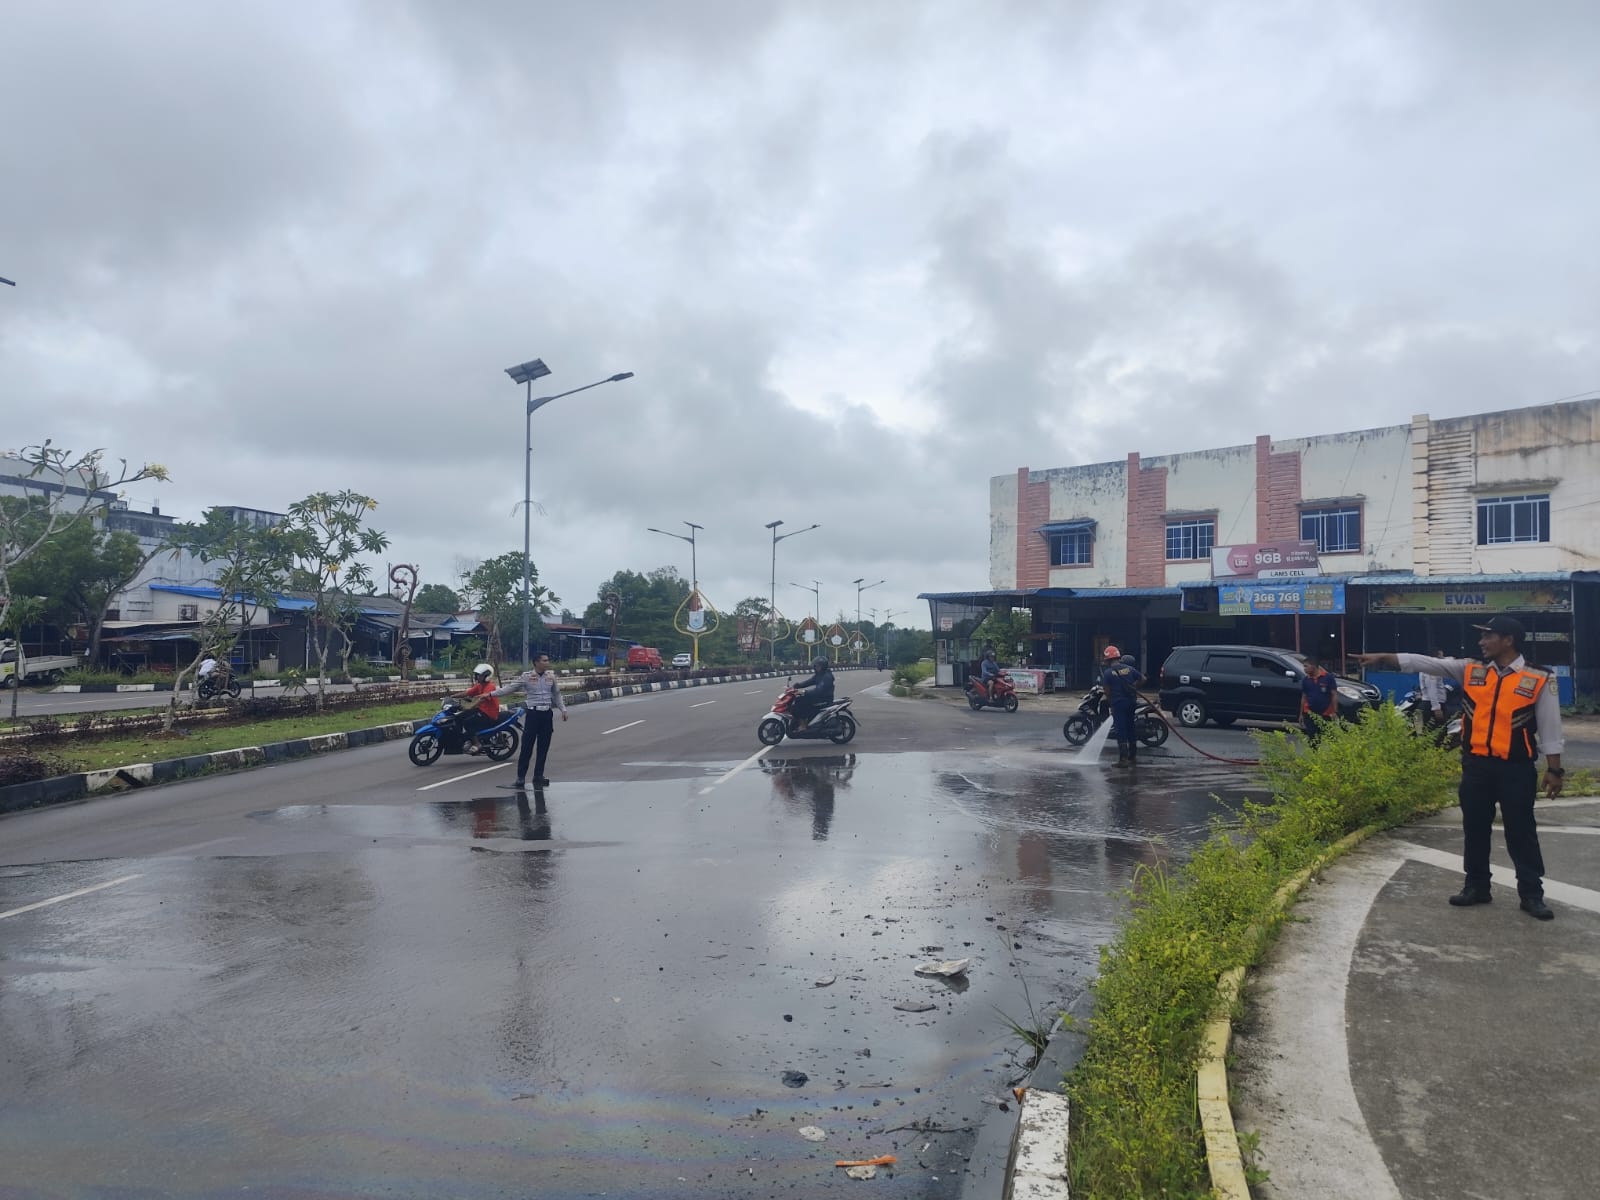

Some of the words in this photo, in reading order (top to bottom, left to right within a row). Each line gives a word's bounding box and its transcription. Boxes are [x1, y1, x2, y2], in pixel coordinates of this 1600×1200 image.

[1255, 552, 1281, 564] 9GB
[1253, 592, 1276, 602] 3GB
[1277, 592, 1300, 602] 7GB
[1445, 594, 1486, 605] EVAN
